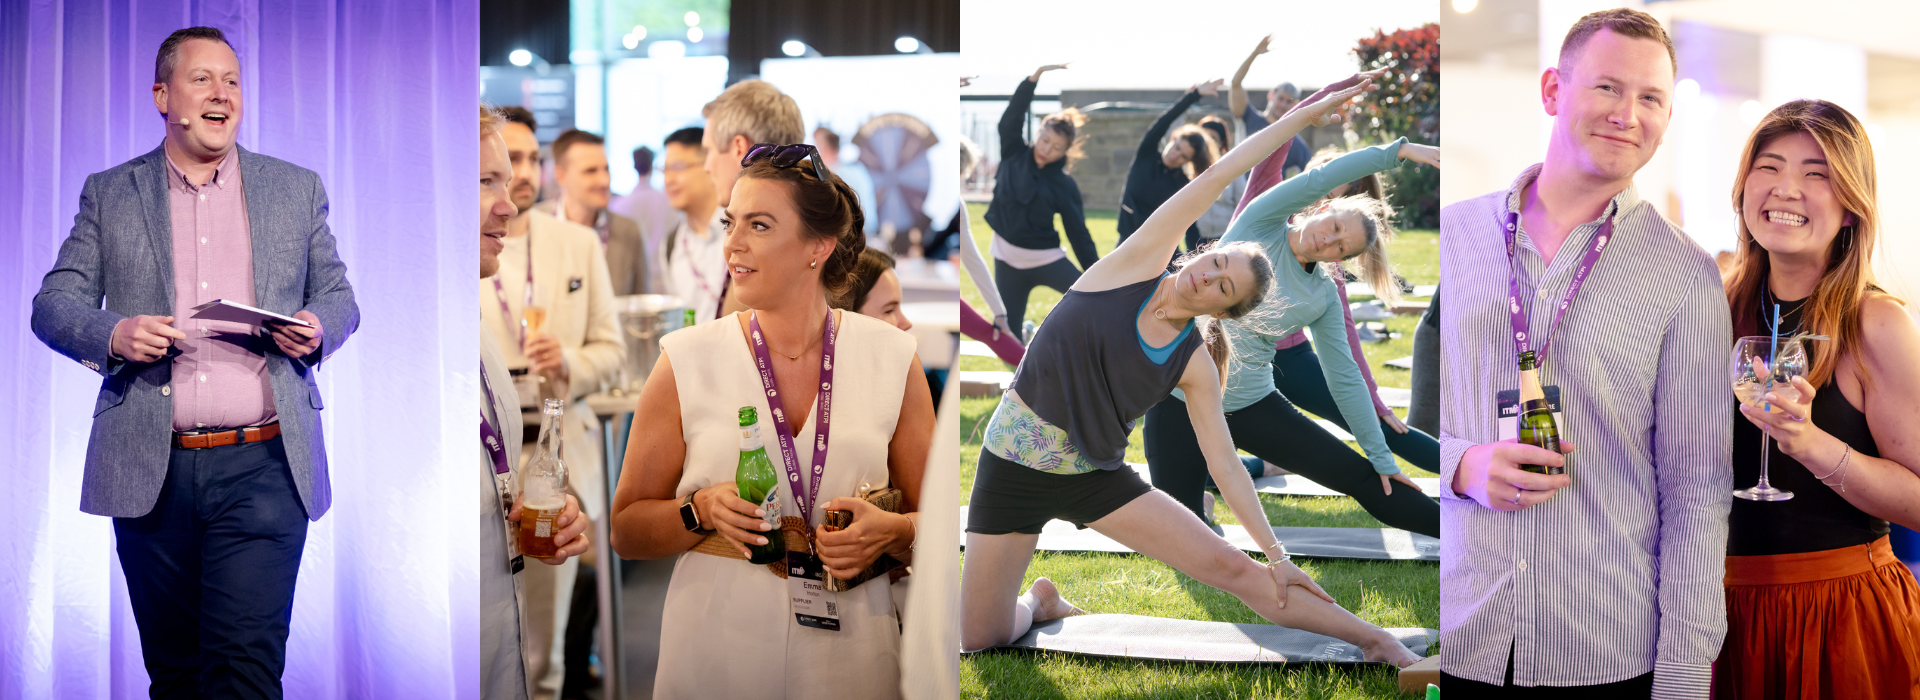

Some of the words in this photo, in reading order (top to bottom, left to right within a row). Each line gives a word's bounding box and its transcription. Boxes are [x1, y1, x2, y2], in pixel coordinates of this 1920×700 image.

[1565, 279, 1579, 300] DIRECT
[761, 369, 771, 389] DIRECT
[823, 391, 831, 411] DIRECT
[783, 449, 794, 472] DIRECT
[803, 582, 822, 590] Emma
